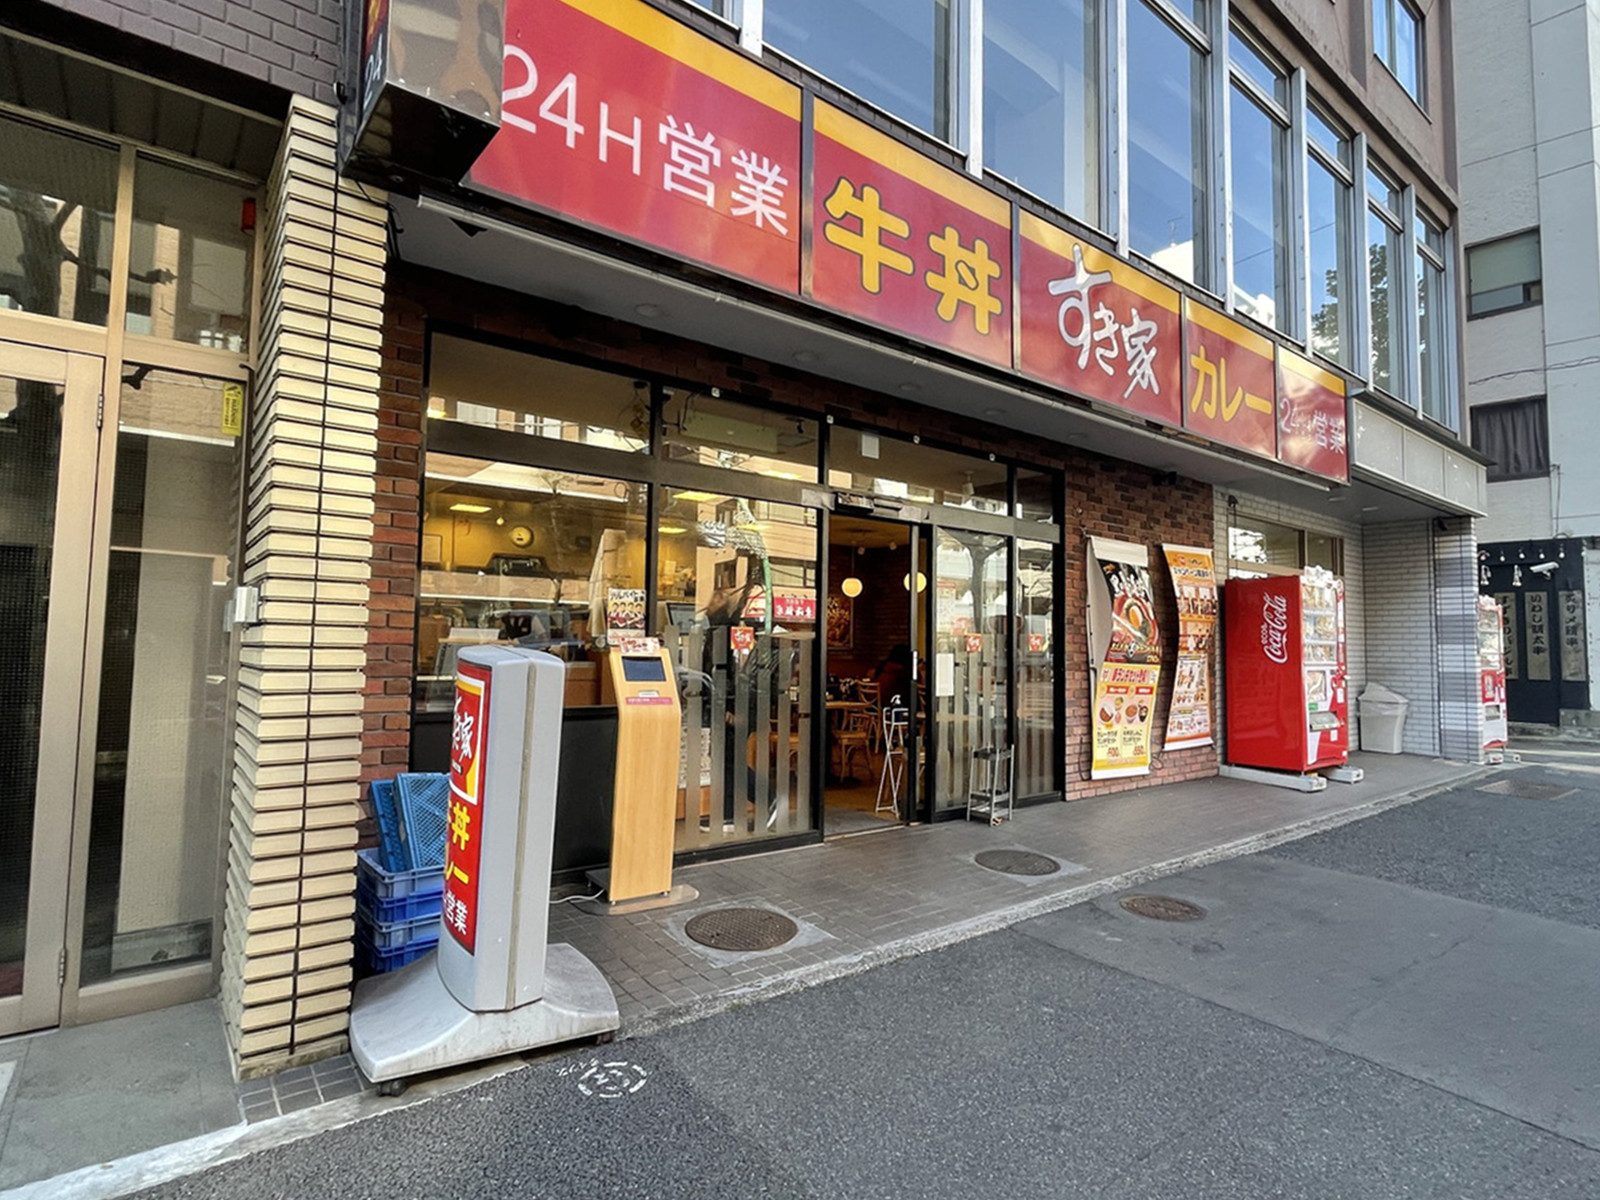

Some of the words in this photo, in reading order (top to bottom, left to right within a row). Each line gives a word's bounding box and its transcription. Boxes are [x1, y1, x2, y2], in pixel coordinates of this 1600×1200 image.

[501, 43, 790, 236] 24H営業
[823, 175, 1003, 336] 牛丼
[1047, 243, 1160, 399] すき家
[1189, 345, 1273, 423] カレー
[1263, 592, 1288, 663] Coca-Cola
[447, 801, 471, 851] 丼
[443, 889, 469, 936] 営業
